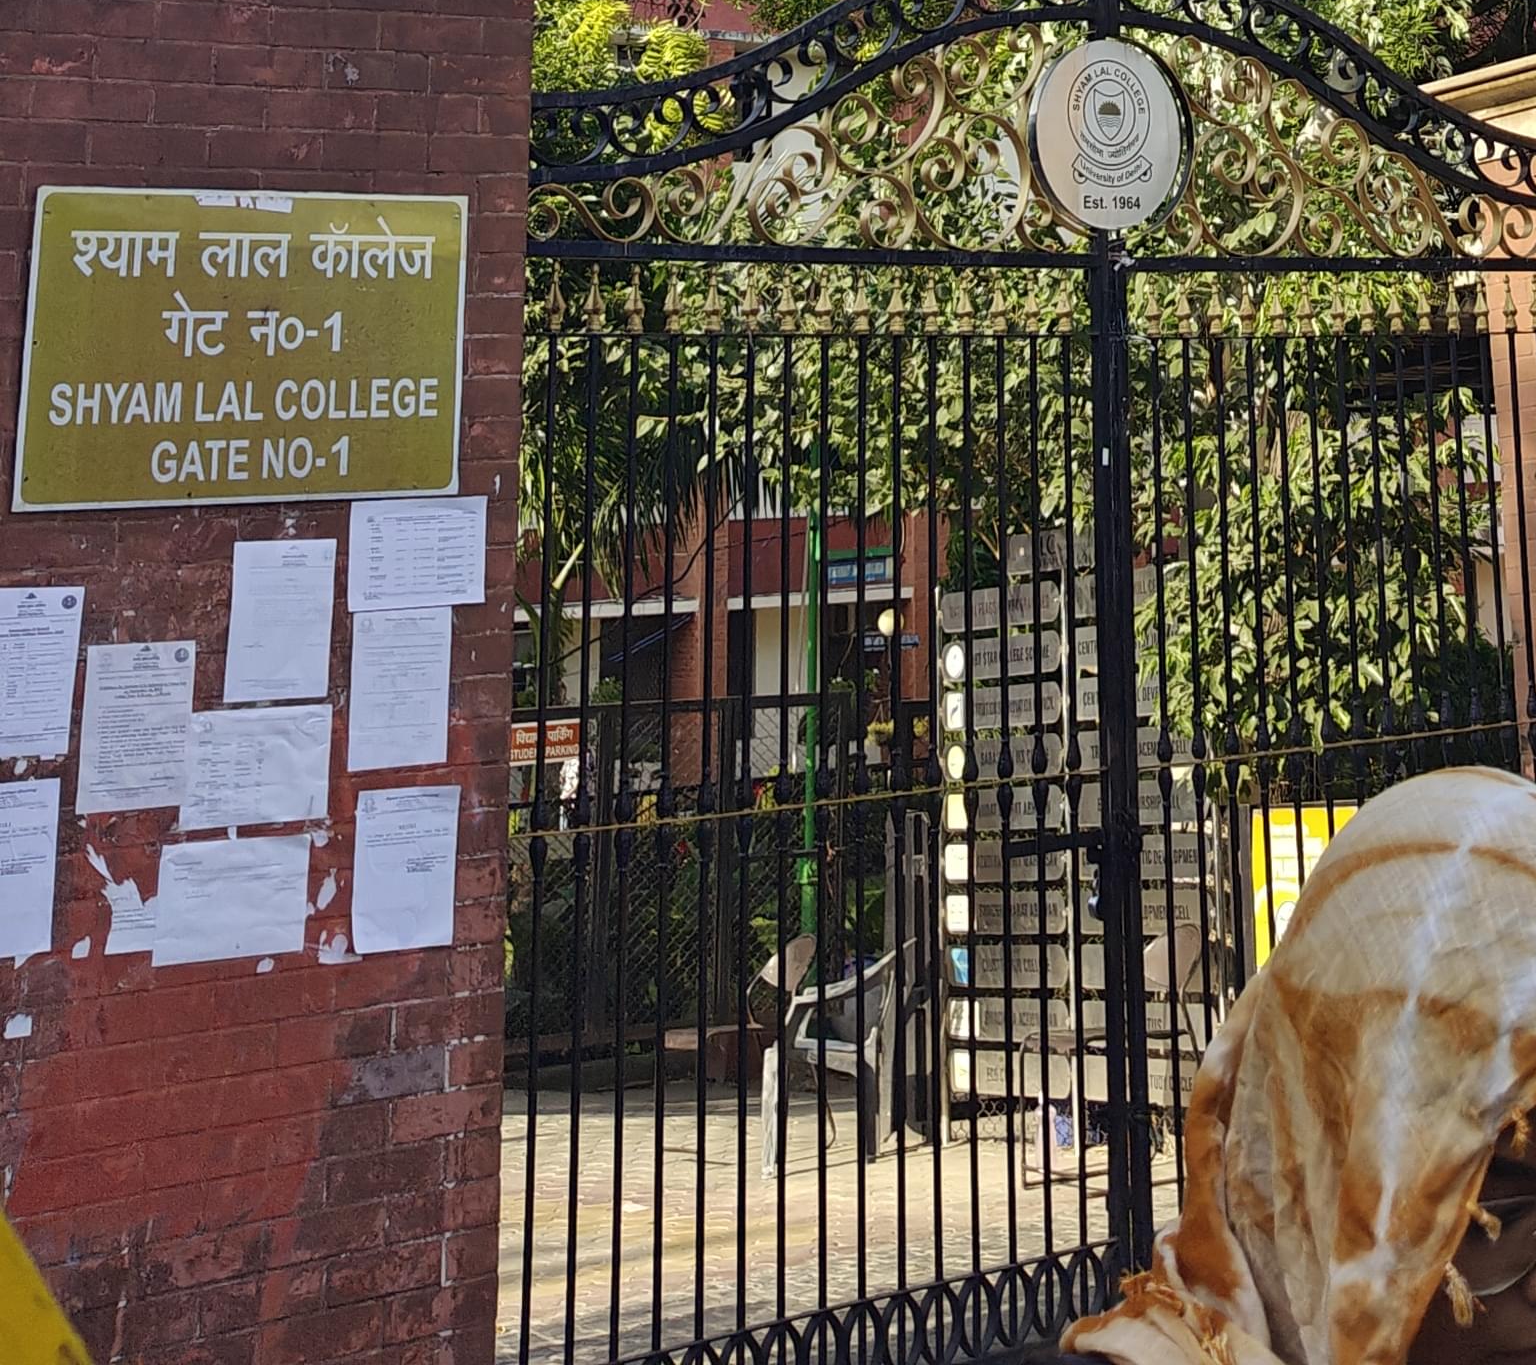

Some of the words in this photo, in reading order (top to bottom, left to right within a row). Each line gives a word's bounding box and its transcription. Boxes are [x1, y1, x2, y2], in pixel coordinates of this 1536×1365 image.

[1072, 72, 1093, 112] SHYAM
[1093, 67, 1111, 81] LAL
[1113, 68, 1146, 115] COLLEGE
[1079, 160, 1116, 184] University
[1116, 173, 1124, 182] of
[1083, 196, 1108, 210] Est.
[1112, 196, 1141, 210] 1964
[71, 230, 177, 280] श्याम
[199, 232, 290, 279] लाल
[161, 292, 229, 360] गेट
[49, 381, 181, 426] SHYAM
[194, 382, 264, 422] LAL
[274, 377, 439, 421] COLLEGE
[150, 438, 250, 484] GATE
[261, 437, 350, 481] NO-1
